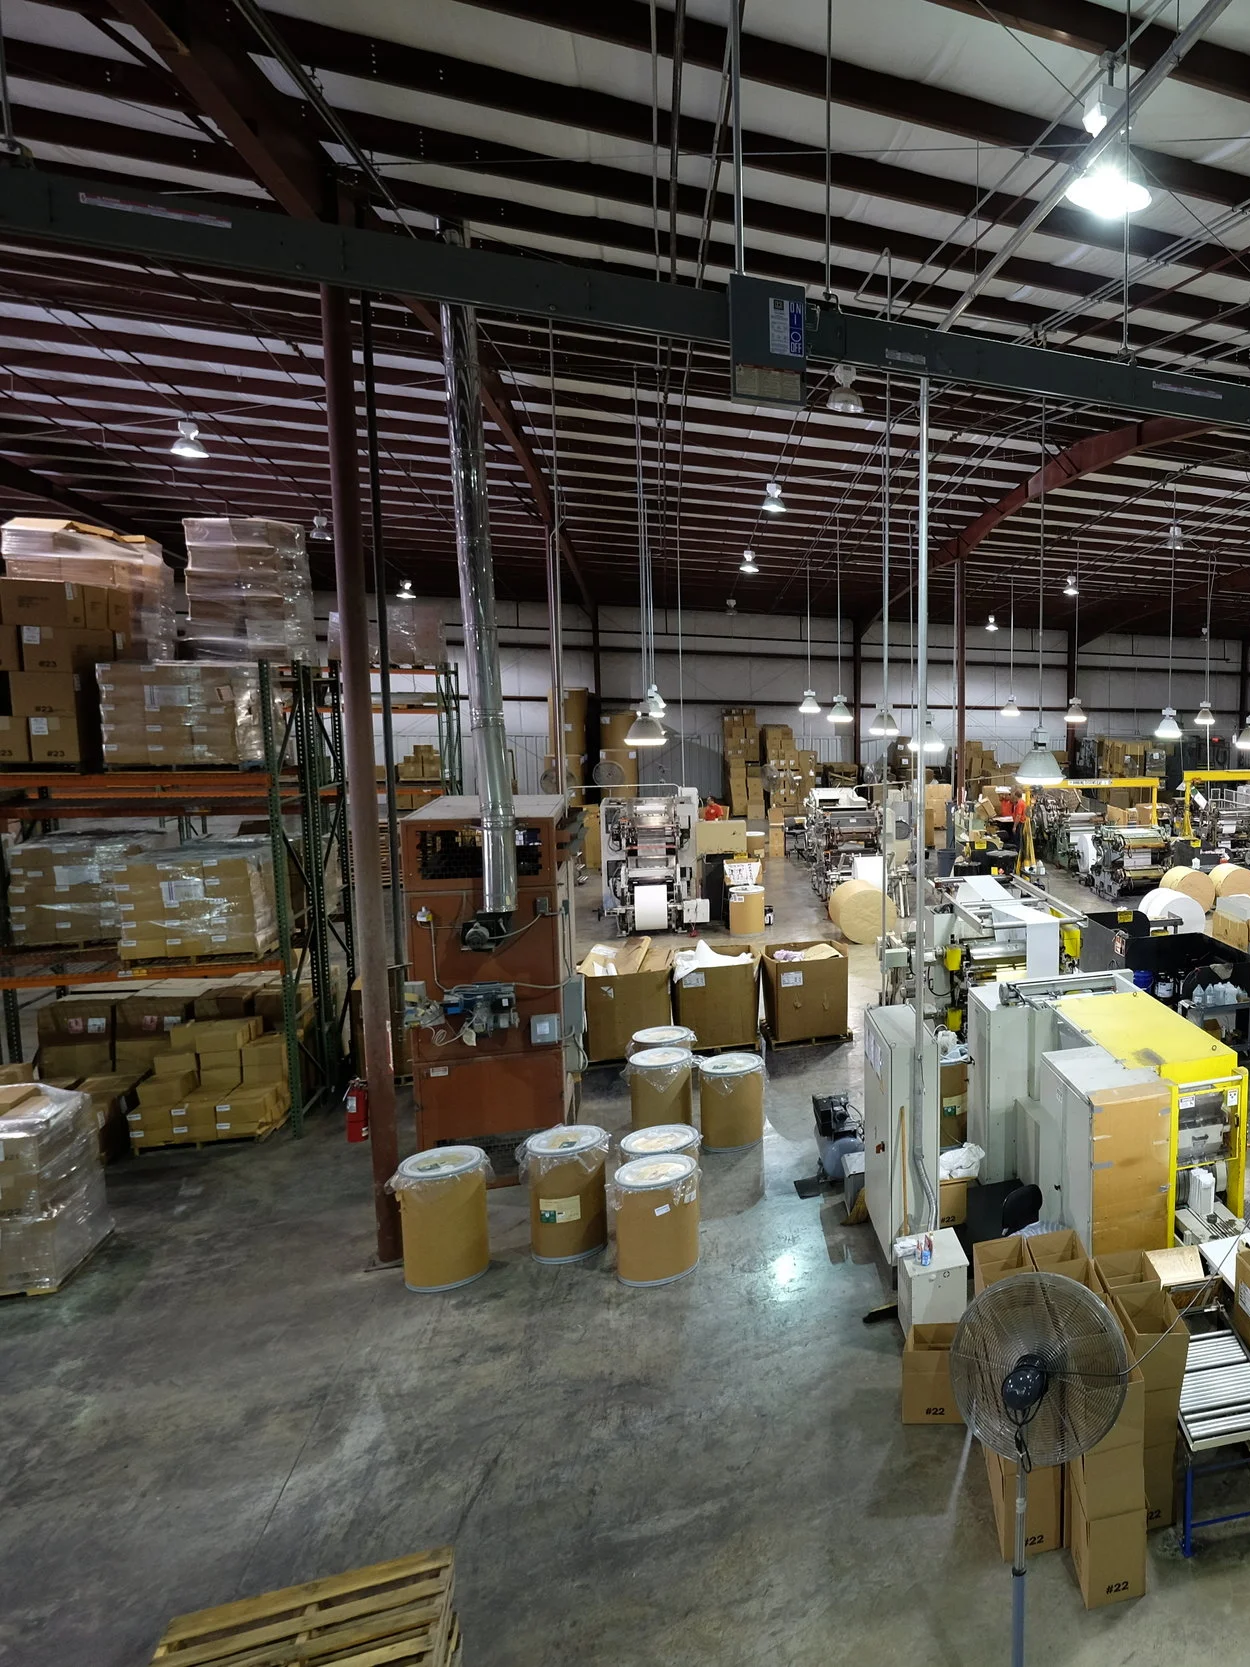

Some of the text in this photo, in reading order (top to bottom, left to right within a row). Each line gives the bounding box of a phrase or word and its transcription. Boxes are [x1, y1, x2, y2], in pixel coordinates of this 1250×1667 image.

[790, 302, 802, 313] ON
[790, 343, 802, 353] OFF
[925, 1408, 945, 1416] #22
[1106, 1581, 1129, 1595] #22
